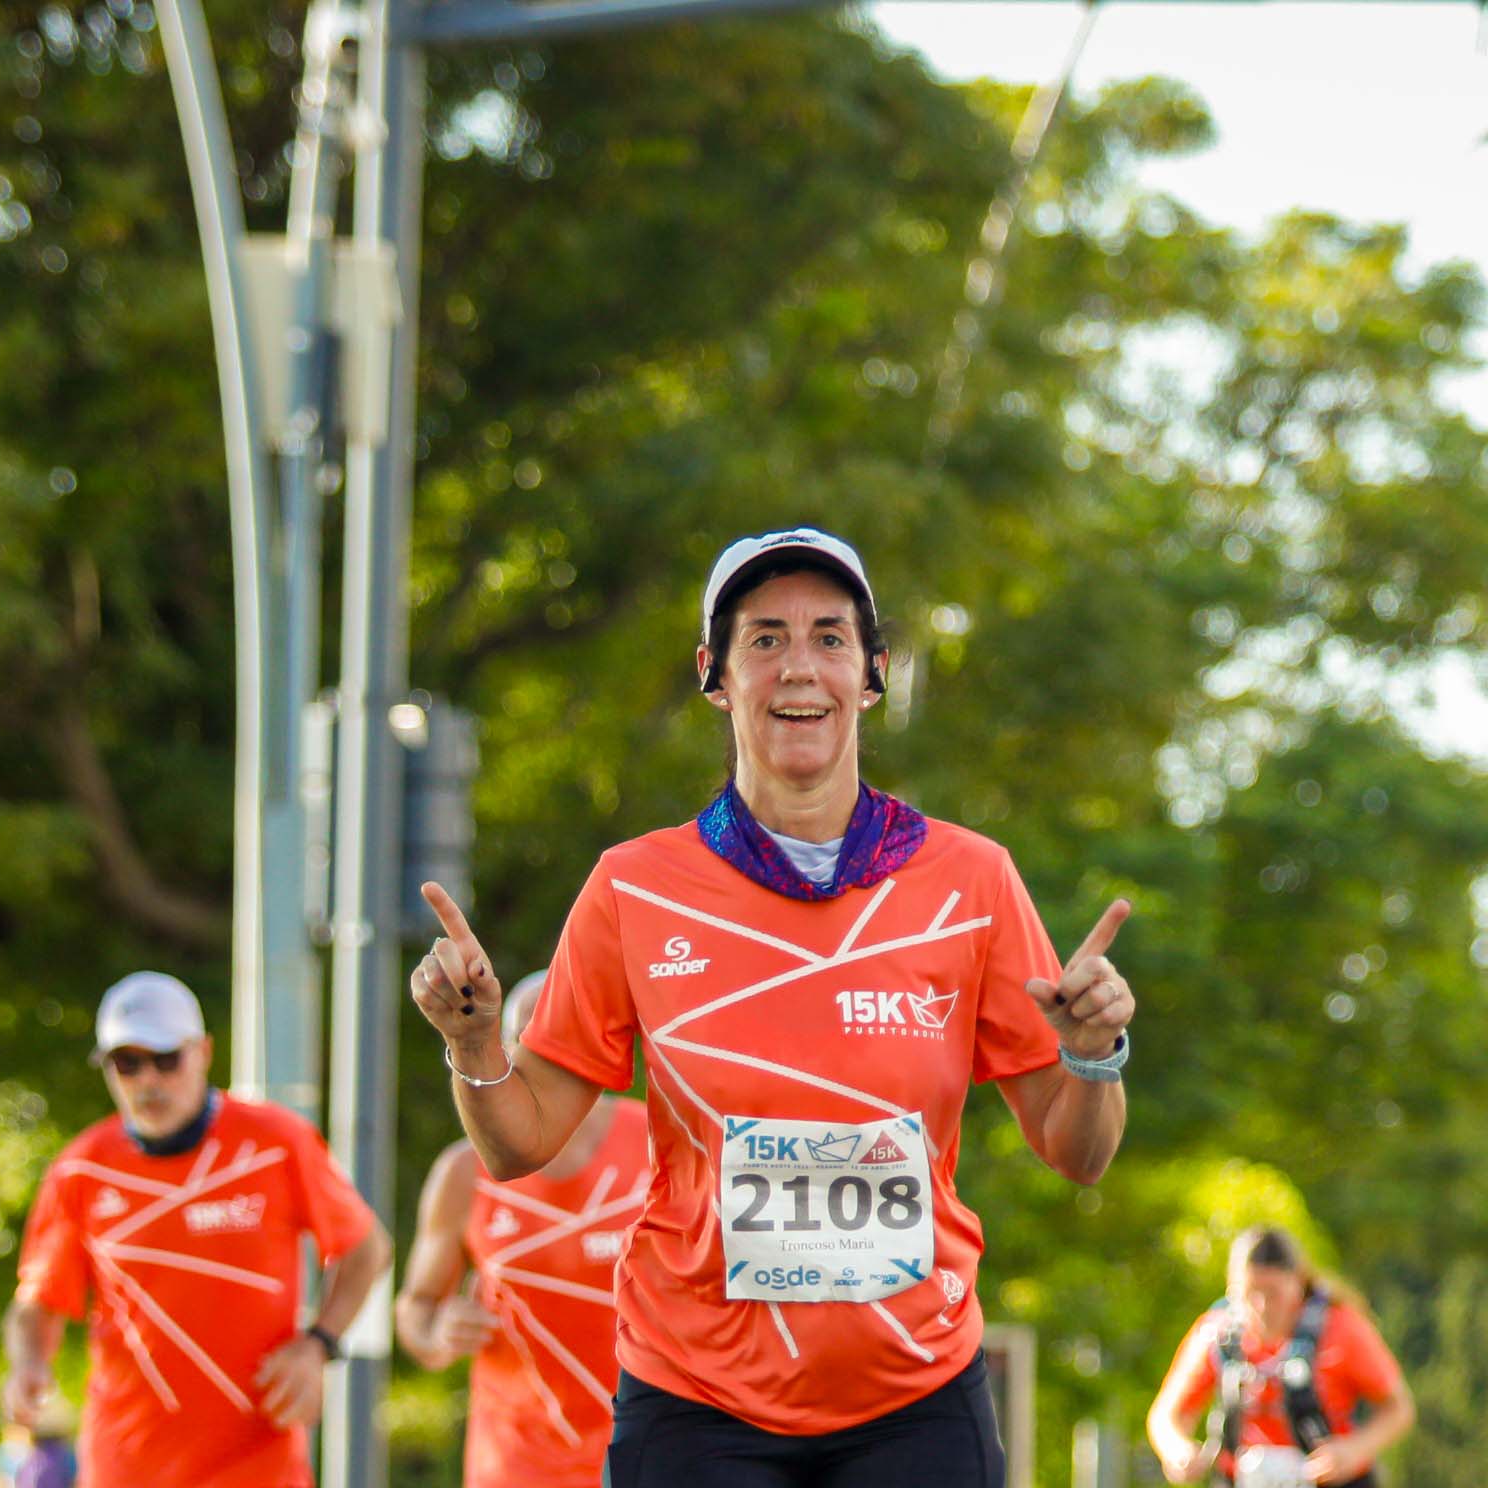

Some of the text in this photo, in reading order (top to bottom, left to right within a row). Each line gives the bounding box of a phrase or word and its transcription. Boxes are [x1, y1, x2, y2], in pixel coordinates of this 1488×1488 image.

[835, 990, 907, 1025] 15K
[844, 1026, 907, 1036] PUERTO
[744, 1134, 799, 1161] 15K
[871, 1144, 899, 1161] 15K
[731, 1173, 923, 1232] 2108
[779, 1238, 875, 1252] Troncoso Maria
[754, 1265, 822, 1289] osde
